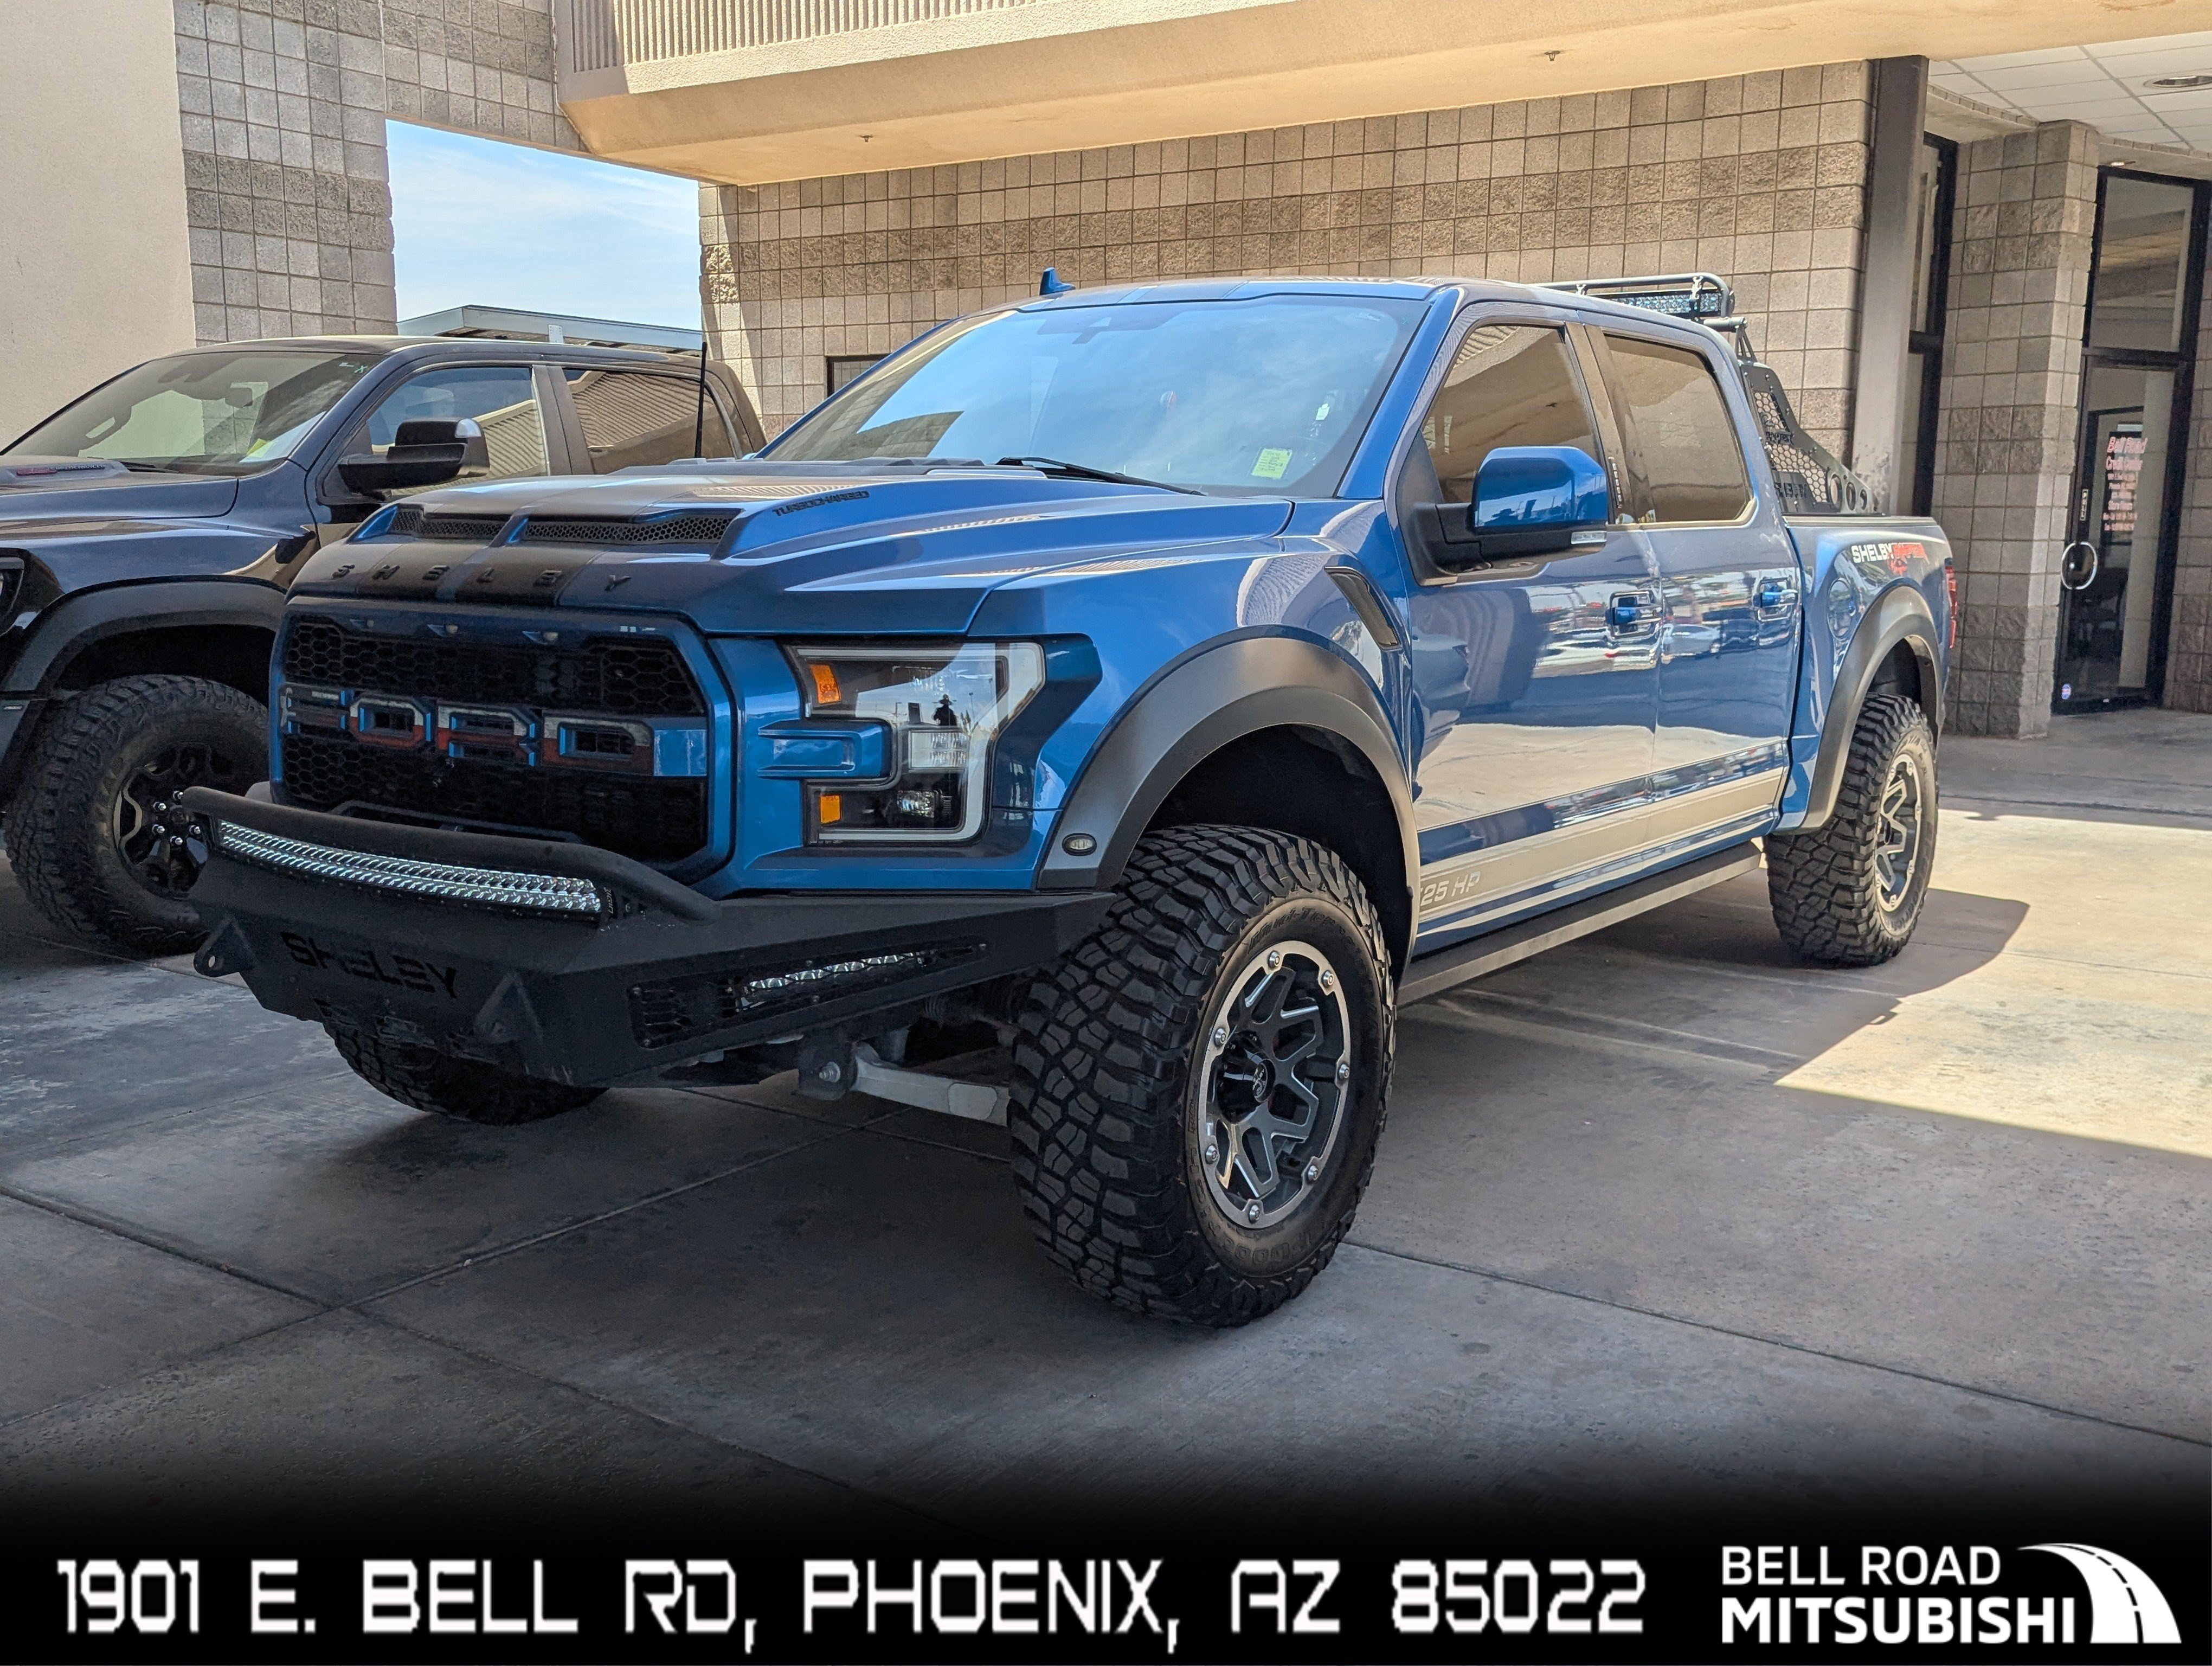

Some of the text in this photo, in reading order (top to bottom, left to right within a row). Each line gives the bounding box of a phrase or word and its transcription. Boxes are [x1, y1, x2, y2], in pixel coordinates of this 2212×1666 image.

[1851, 543, 1894, 563] SHELBY
[331, 564, 632, 592] SHELBY
[278, 681, 652, 774] FORD
[1419, 871, 1481, 907] 25 HP
[281, 931, 458, 999] SHELBY
